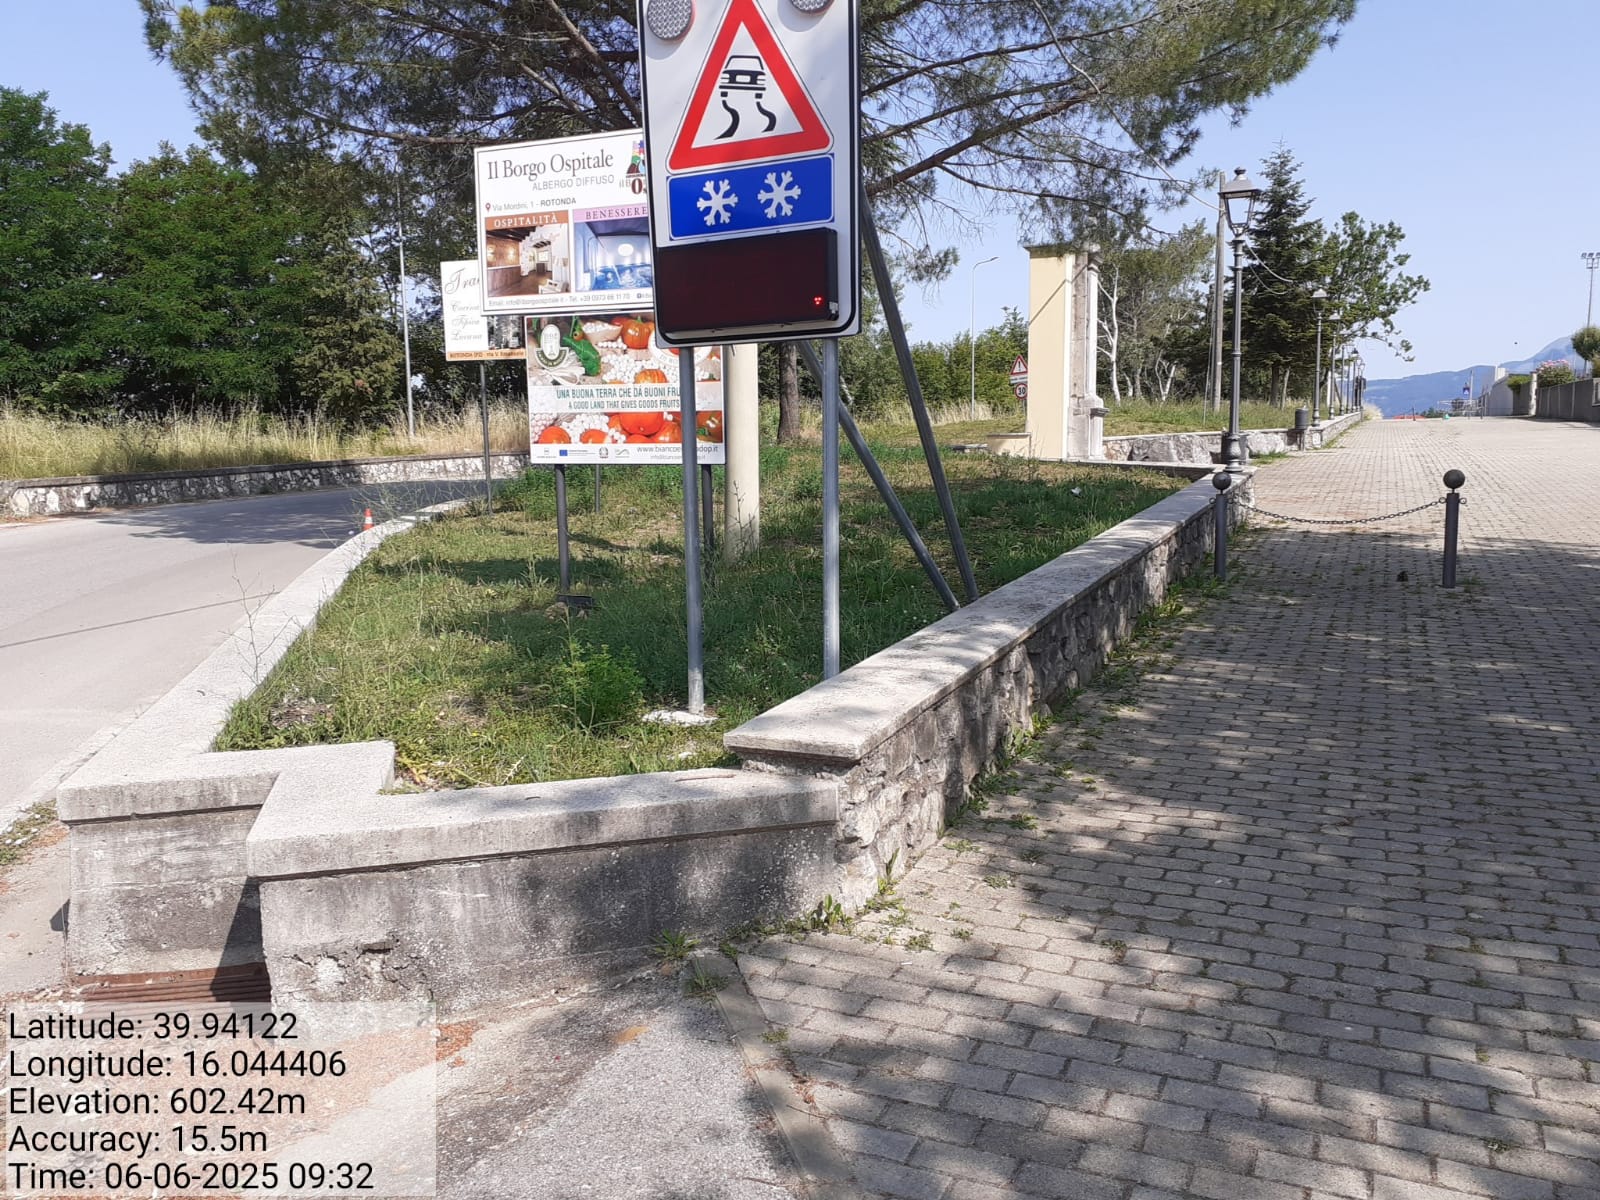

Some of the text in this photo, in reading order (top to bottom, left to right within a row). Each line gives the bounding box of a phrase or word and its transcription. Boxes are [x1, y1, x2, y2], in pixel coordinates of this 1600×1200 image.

[488, 149, 614, 181] Il Borgo Ospitale
[532, 179, 574, 191] ALBERGO
[575, 174, 615, 187] DIFFUSO
[540, 198, 577, 207] ROTONDA
[586, 206, 648, 220] BENESSERE
[494, 212, 558, 228] OSPITALITÀ
[556, 388, 570, 399] UNA
[571, 388, 594, 399] BUONA
[596, 387, 617, 398] TERRA
[619, 387, 631, 398] CHE
[644, 387, 666, 397] BUONI
[1018, 387, 1026, 395] 30
[568, 399, 680, 409] A GOOD LAND THAT GIVES GOODS FRUITS
